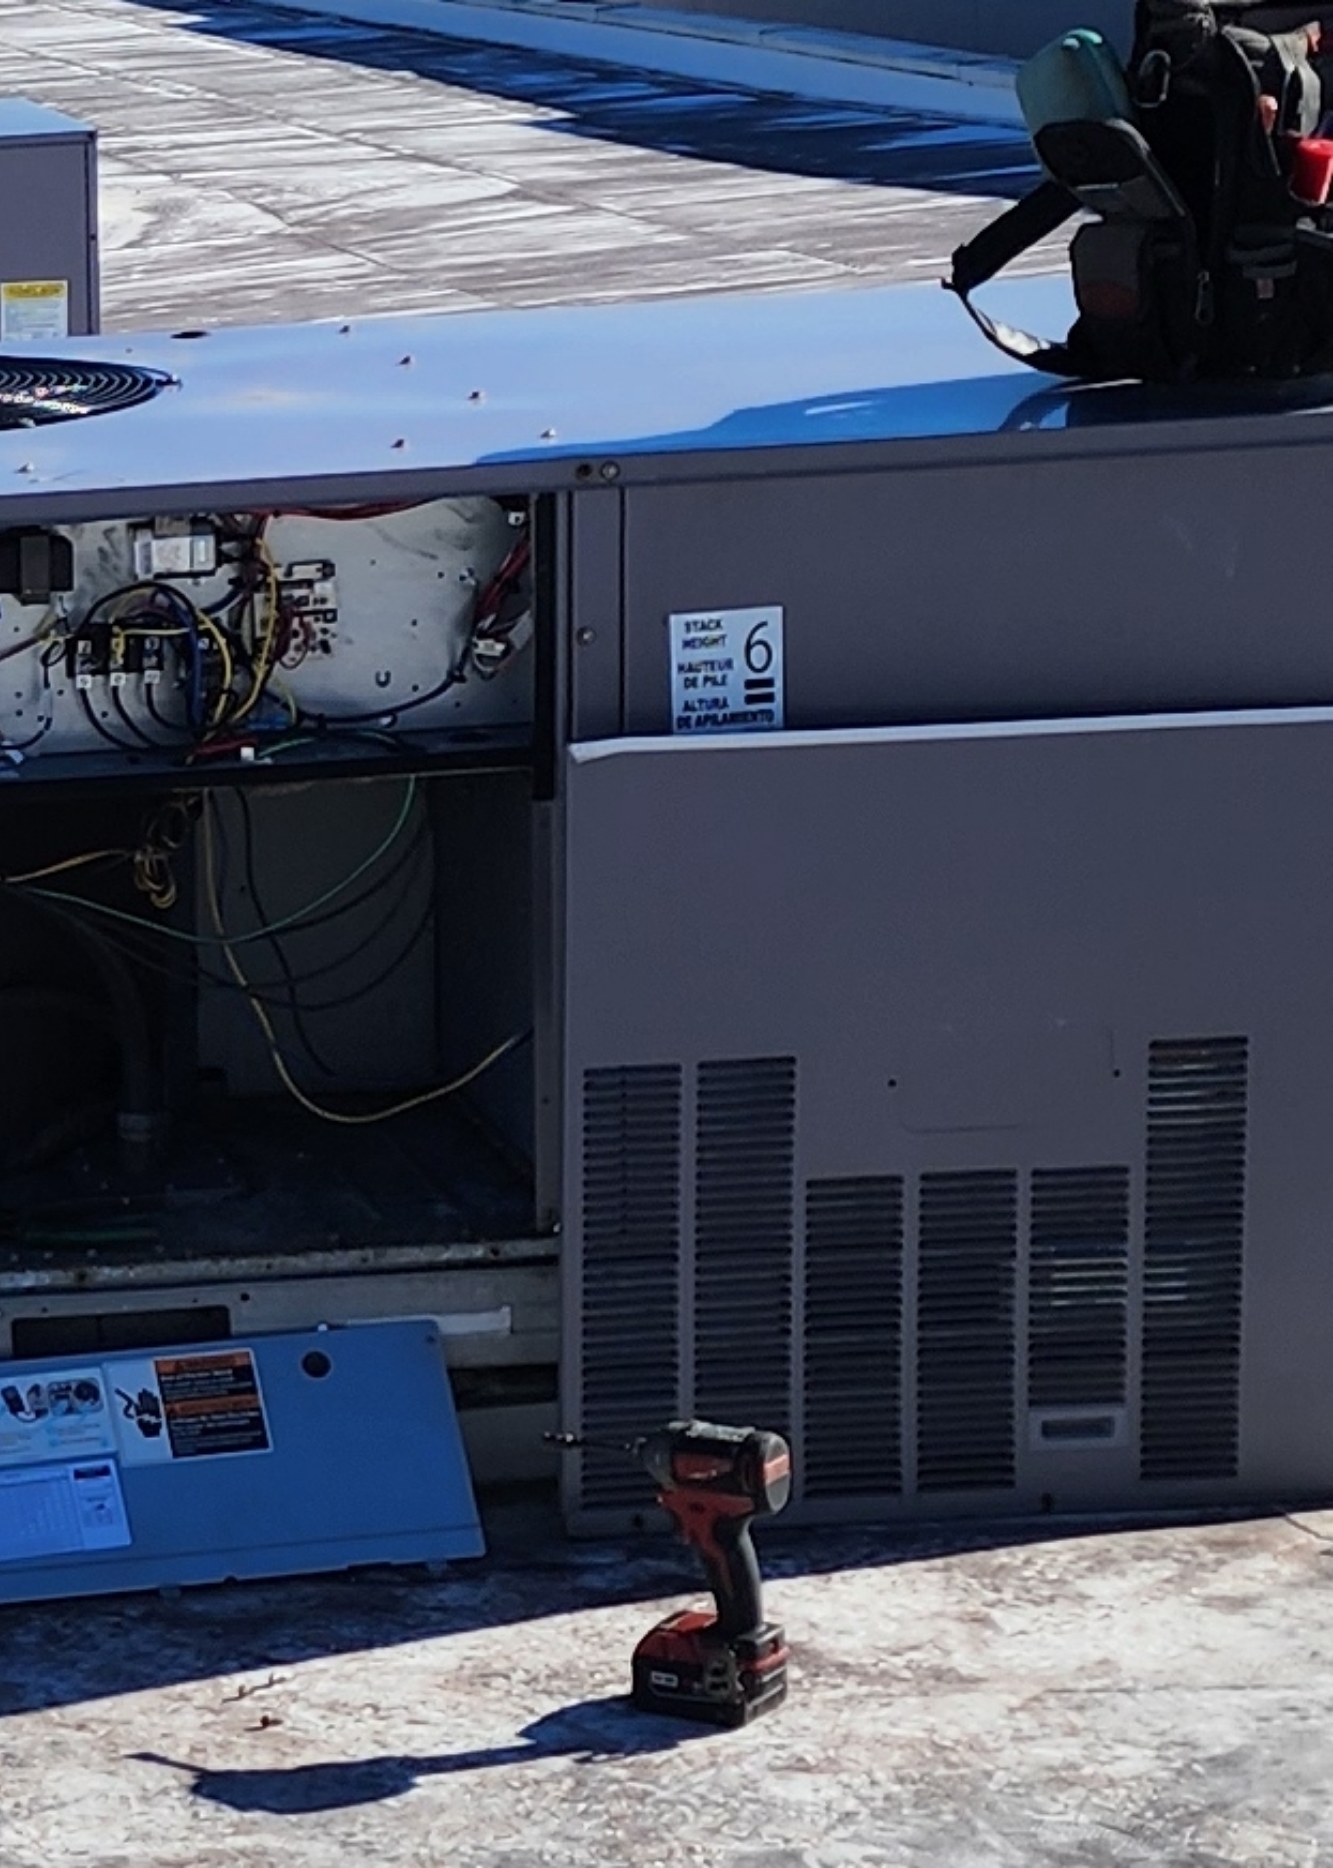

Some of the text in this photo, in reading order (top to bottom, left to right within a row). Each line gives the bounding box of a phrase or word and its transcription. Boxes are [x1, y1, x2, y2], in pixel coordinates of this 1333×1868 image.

[684, 619, 723, 634] STACK
[681, 634, 727, 650] HEIGHT
[744, 620, 773, 673] 6
[677, 658, 734, 674] HAUTEUR
[684, 674, 728, 690] DE PILE
[682, 697, 730, 712] ALTURA
[676, 714, 692, 729] DE
